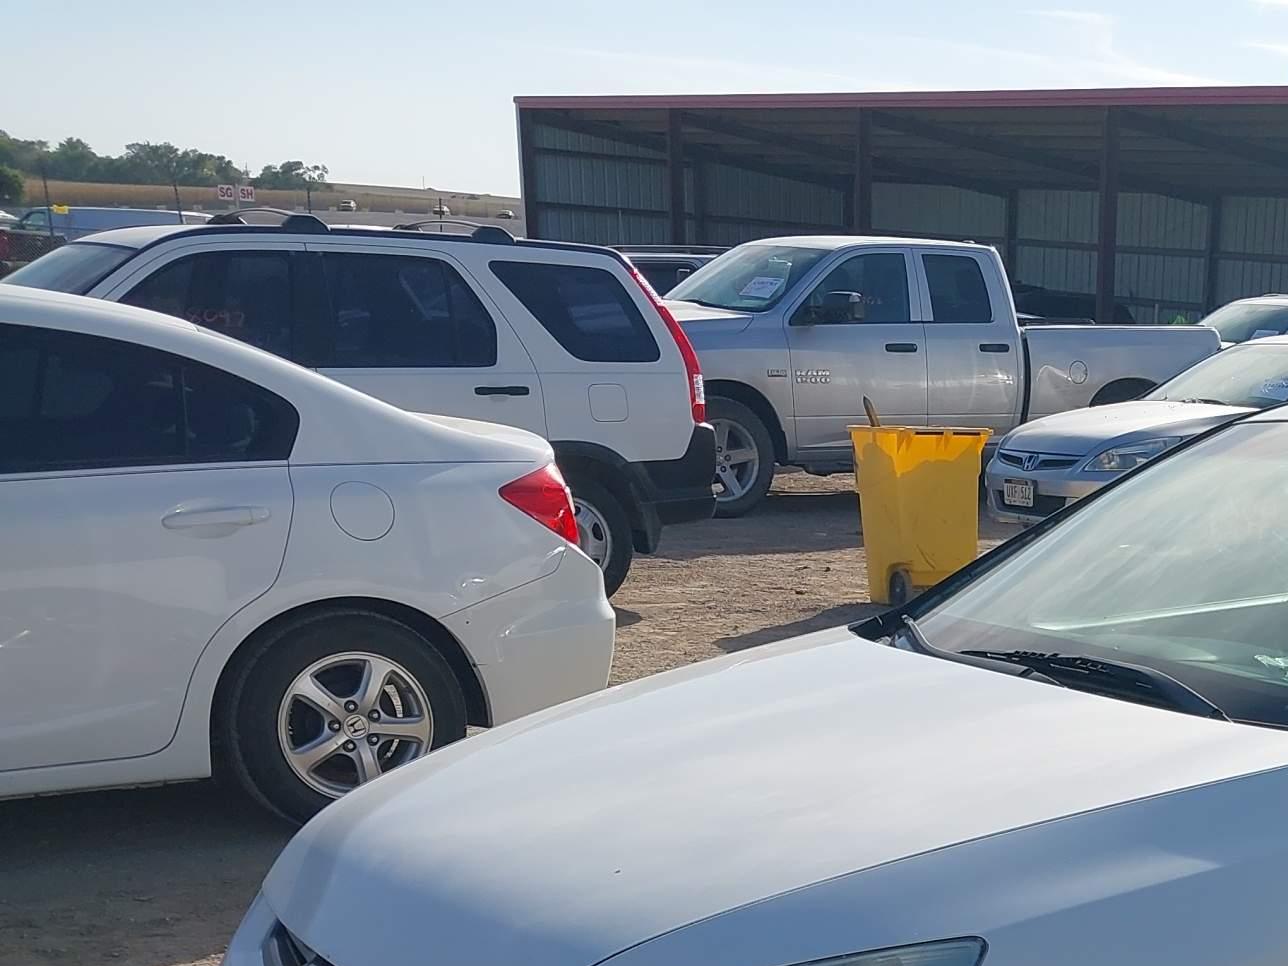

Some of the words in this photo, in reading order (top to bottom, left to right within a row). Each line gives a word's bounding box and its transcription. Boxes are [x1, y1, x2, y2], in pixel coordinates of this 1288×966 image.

[219, 187, 233, 198] SG
[240, 190, 254, 200] SH
[795, 368, 831, 377] RAM
